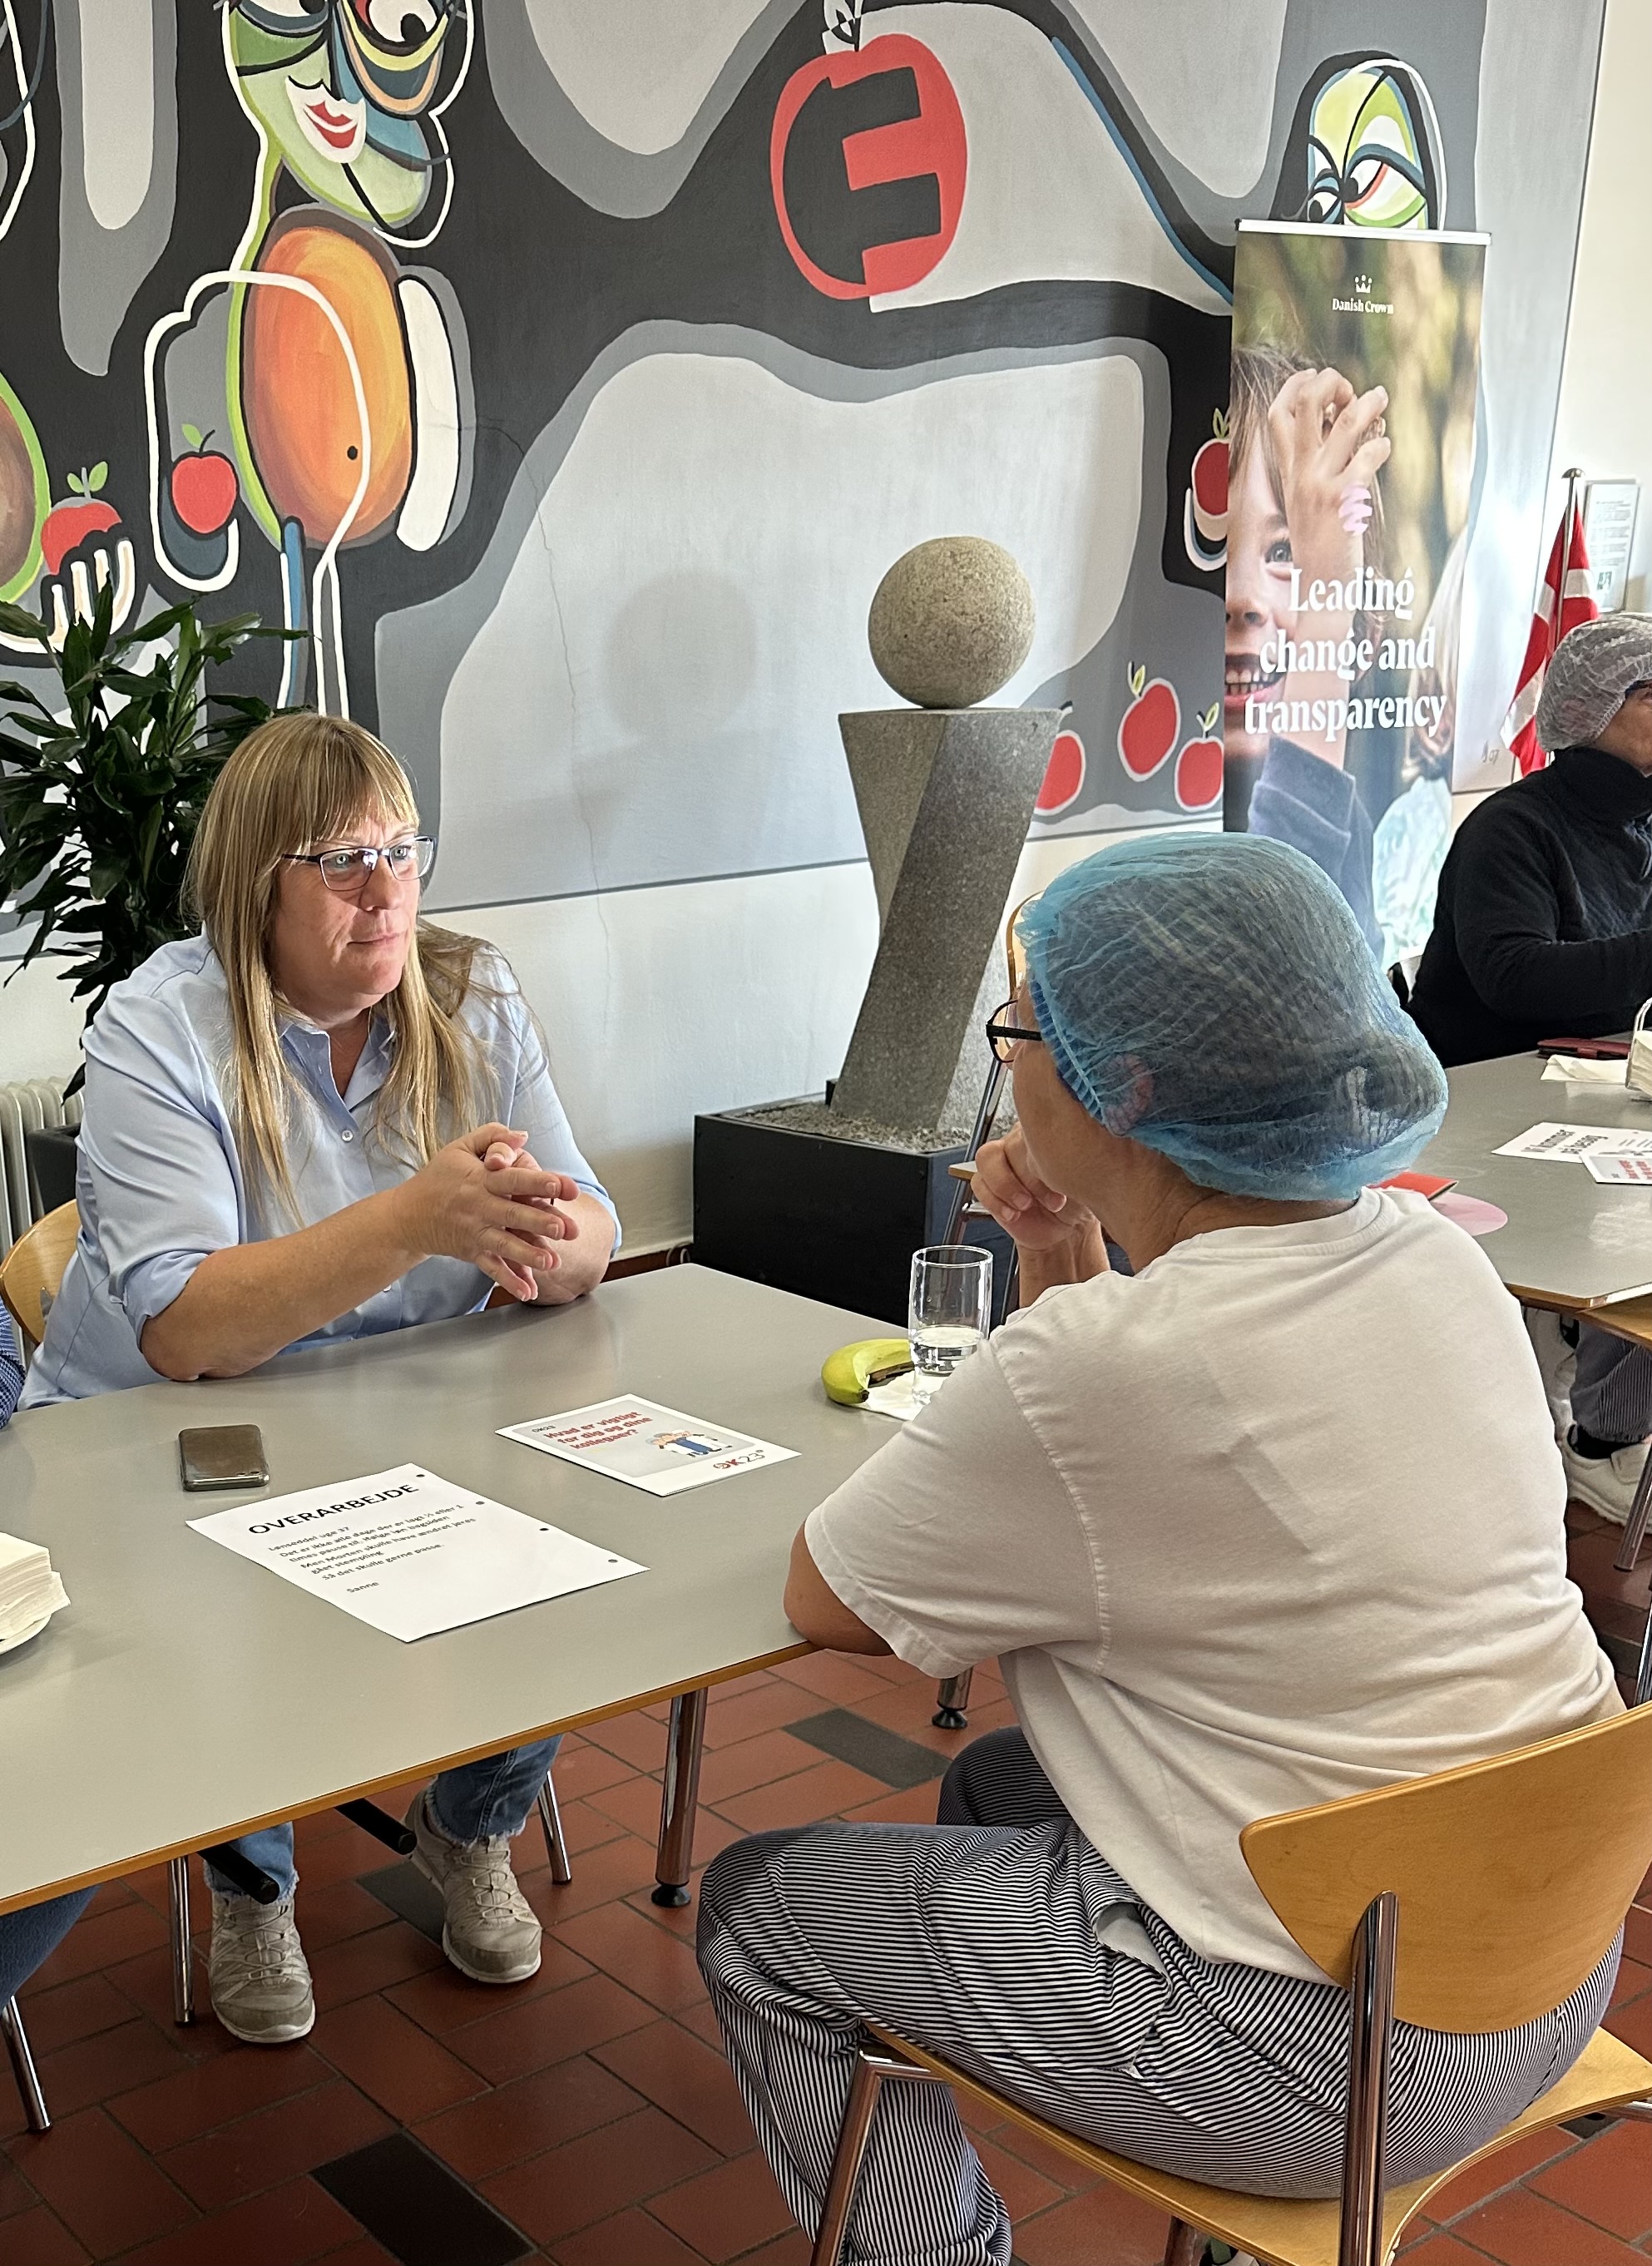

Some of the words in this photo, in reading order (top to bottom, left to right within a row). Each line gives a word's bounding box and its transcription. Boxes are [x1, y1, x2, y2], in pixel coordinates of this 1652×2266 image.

[1332, 298, 1364, 313] Danish
[1365, 300, 1394, 314] Crown
[1289, 566, 1415, 621] Leading
[1260, 626, 1374, 680] change
[1378, 626, 1437, 670] and
[1244, 693, 1447, 742] transparency
[542, 1427, 581, 1439] Hvad
[596, 1412, 642, 1426] vigtigt
[556, 1436, 580, 1444] for
[580, 1430, 606, 1439] dig
[622, 1417, 653, 1427] dine
[569, 1427, 640, 1450] kollegaer?
[248, 1484, 420, 1534] OVERARBEJDE
[289, 1553, 319, 1562] times
[318, 1544, 349, 1556] pause
[407, 1516, 450, 1530] bagsiden
[299, 1560, 326, 1569] Men
[324, 1549, 364, 1562] Morten
[364, 1541, 393, 1551] skulle
[391, 1534, 418, 1542] have
[417, 1524, 453, 1536] ændret
[451, 1518, 477, 1527] jeres
[310, 1541, 334, 1550] ikke
[352, 1529, 377, 1537] dage
[434, 1507, 456, 1515] eller
[310, 1565, 334, 1575] gået
[334, 1551, 384, 1567] stempling
[336, 1568, 355, 1576] det
[354, 1560, 385, 1571] skulle
[384, 1551, 414, 1563] gerne
[346, 1581, 379, 1593] Sanne
